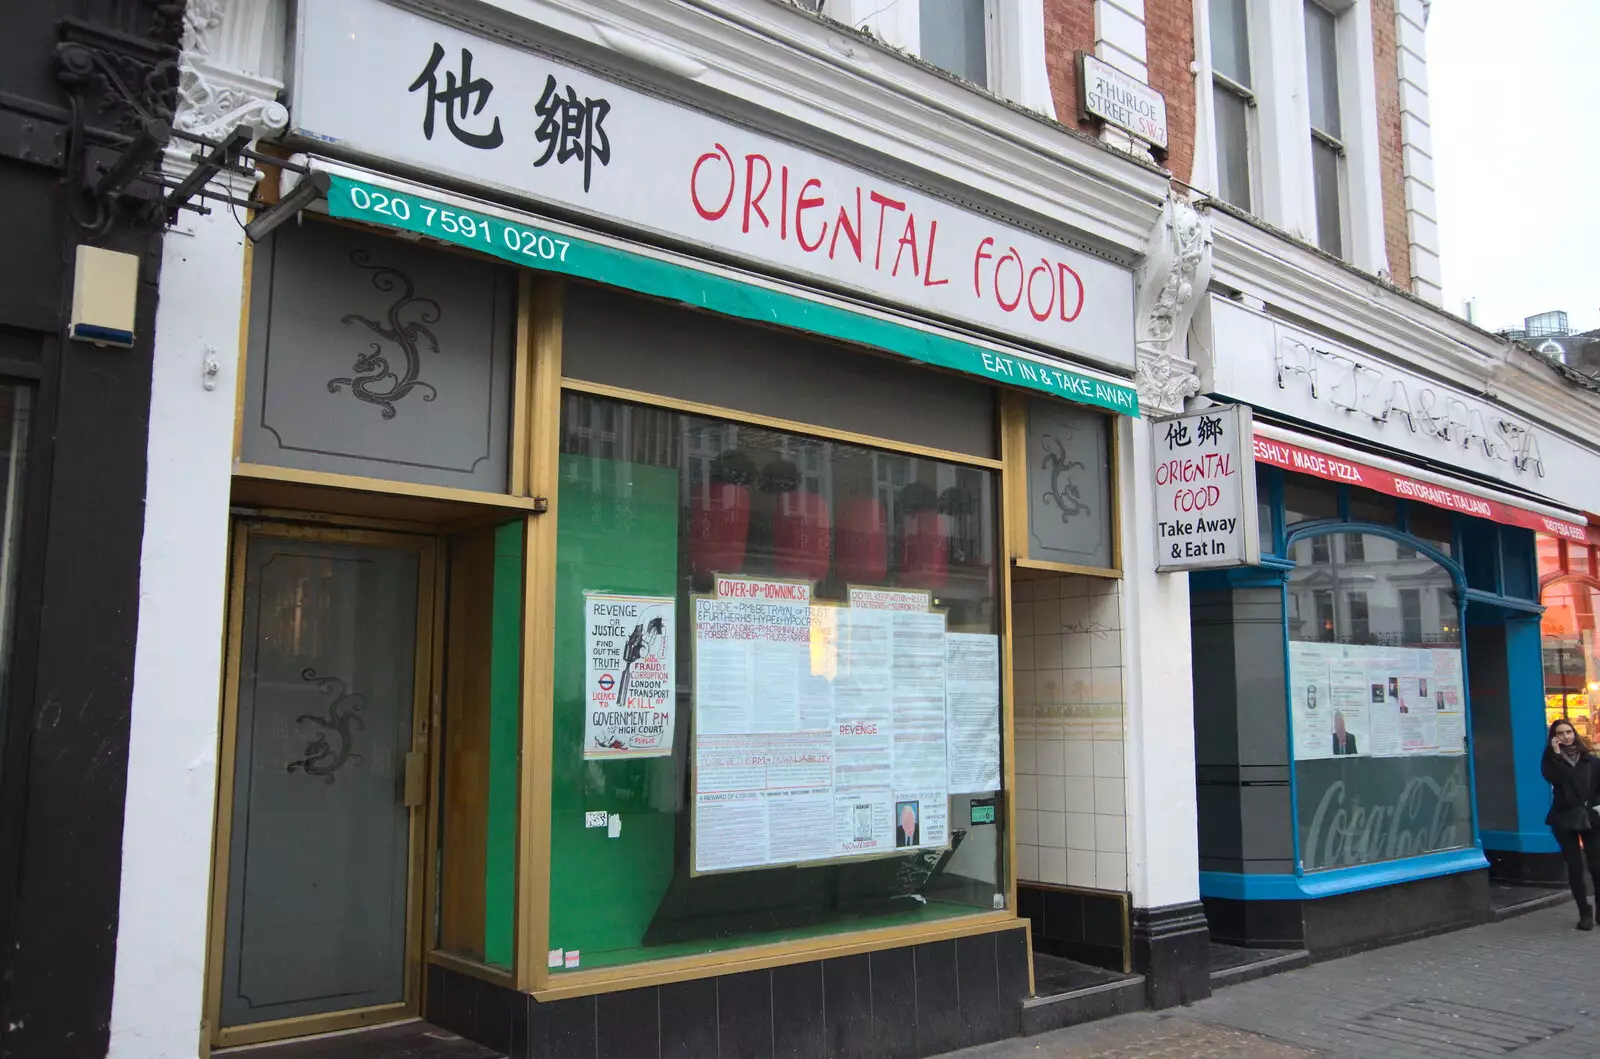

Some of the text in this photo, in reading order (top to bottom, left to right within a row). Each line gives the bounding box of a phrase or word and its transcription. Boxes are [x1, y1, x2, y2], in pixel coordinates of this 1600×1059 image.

[1096, 77, 1157, 121] THURLOE
[409, 42, 612, 193] 他鄉
[350, 187, 571, 262] 020 7591 0207
[690, 143, 1084, 323] ORIENTAL FOOD
[981, 352, 1134, 410] EAT IN & TAKE AWAY
[1164, 415, 1223, 451] 他鄉
[1253, 439, 1363, 482] ESHLY MADE PIZZA
[1155, 453, 1235, 486] ORIENTAL
[1173, 485, 1221, 512] FOOD
[1394, 478, 1491, 516] RISTORANTE ITALIANO
[1159, 517, 1237, 537] Take Away
[1171, 539, 1226, 559] & Eat In
[593, 604, 638, 617] REVENGE
[609, 619, 620, 627] OR
[592, 625, 626, 637] JUSTICE
[593, 648, 620, 656] OUT THE
[592, 658, 620, 668] TRUTH
[634, 662, 661, 671] FRAUD
[630, 671, 669, 680] CORRUPTION
[631, 680, 661, 689] LONDON
[592, 692, 616, 701] LICENCE
[629, 689, 670, 699] TRANSPORT
[627, 697, 655, 709] KILL
[592, 711, 650, 726] GOVERNMENT
[618, 726, 636, 734] HIGH
[839, 724, 878, 736] REVENGE
